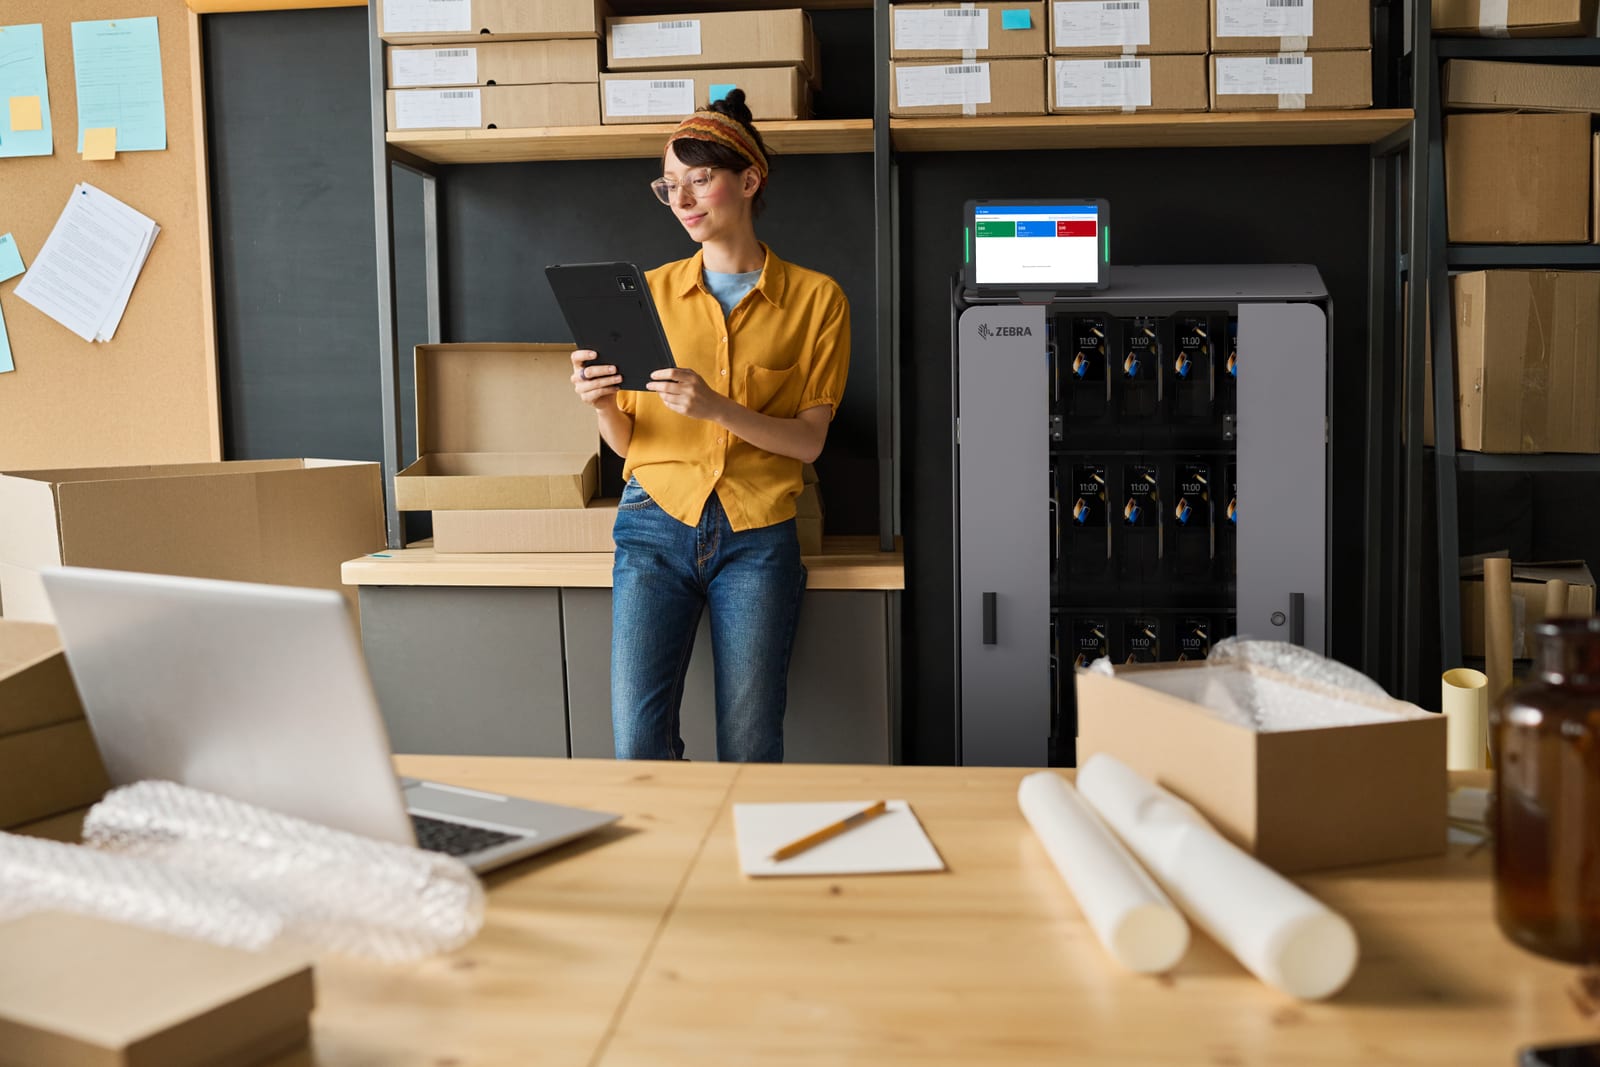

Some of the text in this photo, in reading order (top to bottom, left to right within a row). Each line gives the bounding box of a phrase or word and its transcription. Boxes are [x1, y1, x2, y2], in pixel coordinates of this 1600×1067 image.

[996, 326, 1032, 337] ZEBRA
[1079, 337, 1098, 345] 11:00
[1130, 337, 1149, 345] 11:00
[1181, 337, 1200, 345] 11:00
[1080, 483, 1098, 492] 11:00
[1131, 483, 1149, 492] 11:00
[1182, 483, 1200, 492] 11:00
[1080, 638, 1098, 647] 11:00
[1131, 638, 1149, 647] 11:00
[1182, 638, 1200, 647] 11:00
